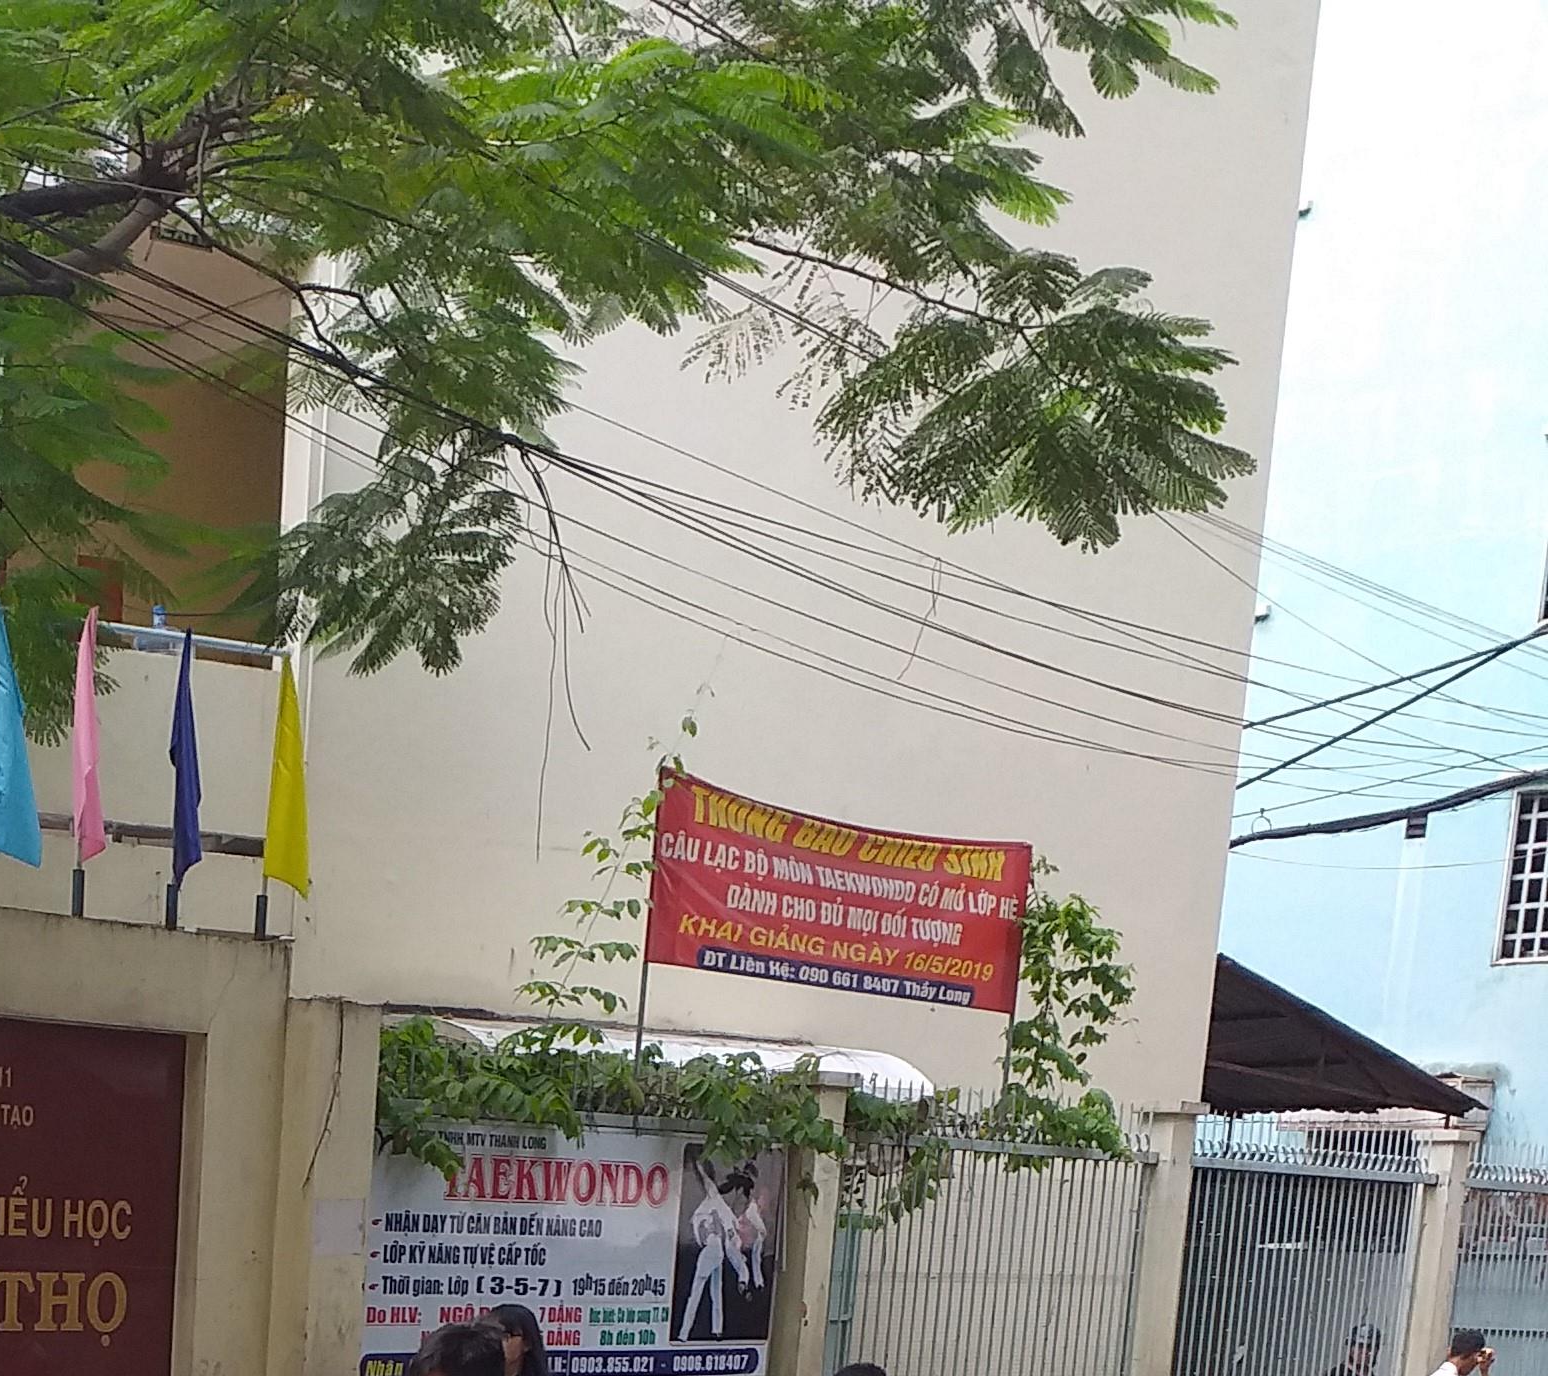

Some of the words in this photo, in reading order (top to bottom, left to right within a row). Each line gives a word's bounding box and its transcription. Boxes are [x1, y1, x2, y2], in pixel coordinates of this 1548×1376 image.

[660, 830, 700, 863] CÂU
[704, 841, 740, 874] LẠC
[744, 848, 769, 882] BỘ
[772, 855, 813, 886] MÔN
[815, 864, 917, 904] TAEKWONDO
[918, 880, 940, 908] CÓ
[940, 882, 966, 912] MỞ
[968, 888, 997, 916] LỚP
[999, 894, 1019, 920] HÈ
[943, 846, 1005, 882] SINH
[727, 882, 777, 916] DÀNH
[782, 895, 816, 923] CHO
[847, 906, 879, 937] MỌI
[911, 917, 964, 948] TƯỢNG
[678, 913, 743, 943] KHAI
[750, 923, 824, 955] GIẢNG
[832, 940, 900, 966] NGÀY
[904, 951, 994, 981] 16/5/2019
[703, 950, 726, 967] ĐT
[730, 953, 765, 975] Liên
[769, 962, 796, 982] Hệ:
[799, 966, 829, 984] 090
[832, 971, 859, 988] 661
[863, 976, 900, 994] 8407
[903, 980, 937, 998] Thầy
[939, 985, 971, 1005] Long
[1, 1104, 34, 1129] TẠO
[467, 1133, 487, 1146] MTV
[489, 1134, 520, 1148] THANH
[522, 1135, 547, 1149] LONG
[63, 1200, 132, 1246] HỌC
[384, 1210, 421, 1236] NHẬN
[422, 1213, 448, 1237] DẠY
[545, 1217, 577, 1238] NÂNG
[579, 1219, 603, 1239] CAO
[462, 1245, 480, 1269] TỰ
[480, 1244, 496, 1269] VỆ
[497, 1243, 522, 1266] CẤP
[524, 1242, 547, 1266] TỐC
[381, 1275, 410, 1295] Thời
[412, 1276, 444, 1296] gian:
[448, 1275, 469, 1296] Lớp
[572, 1272, 606, 1296] 19h15
[608, 1275, 630, 1296] đến
[631, 1273, 666, 1297] 20h45
[367, 1306, 386, 1324] Do
[390, 1306, 422, 1324] HLV:
[539, 1307, 546, 1324] 7
[639, 1329, 656, 1346] 10h
[571, 1356, 654, 1374] 0903.855.021
[673, 1354, 749, 1373] 0906.618407
